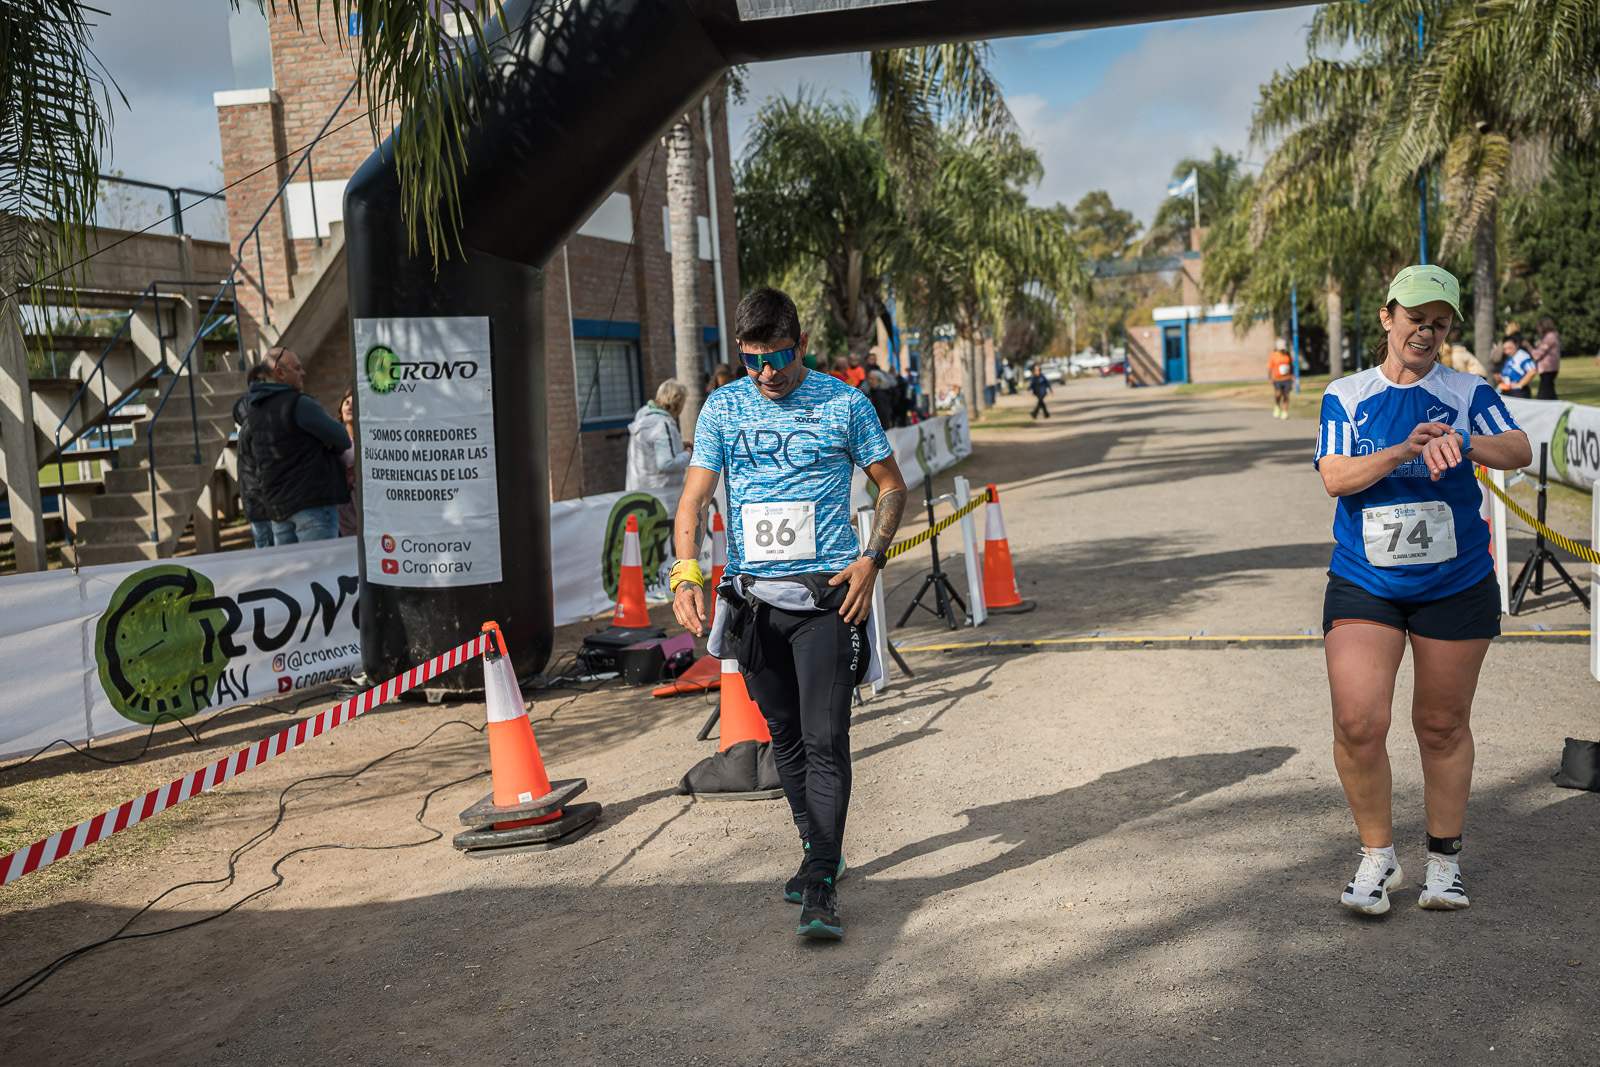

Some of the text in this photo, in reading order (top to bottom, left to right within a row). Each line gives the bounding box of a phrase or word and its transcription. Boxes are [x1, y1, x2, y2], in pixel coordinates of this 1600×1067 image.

[388, 383, 417, 393] RAV
[404, 428, 477, 442] CORREDORES
[364, 447, 488, 461] BUSCANDO MEJORAR LAS
[731, 430, 819, 469] ARG
[372, 467, 478, 481] EXPERIENCIAS DE LOS
[755, 518, 796, 547] 86
[1383, 520, 1434, 552] 74
[401, 539, 472, 553] Cronorav
[402, 559, 473, 573] Cronorav
[295, 664, 355, 689] cronorav
[190, 664, 250, 711] RAV
